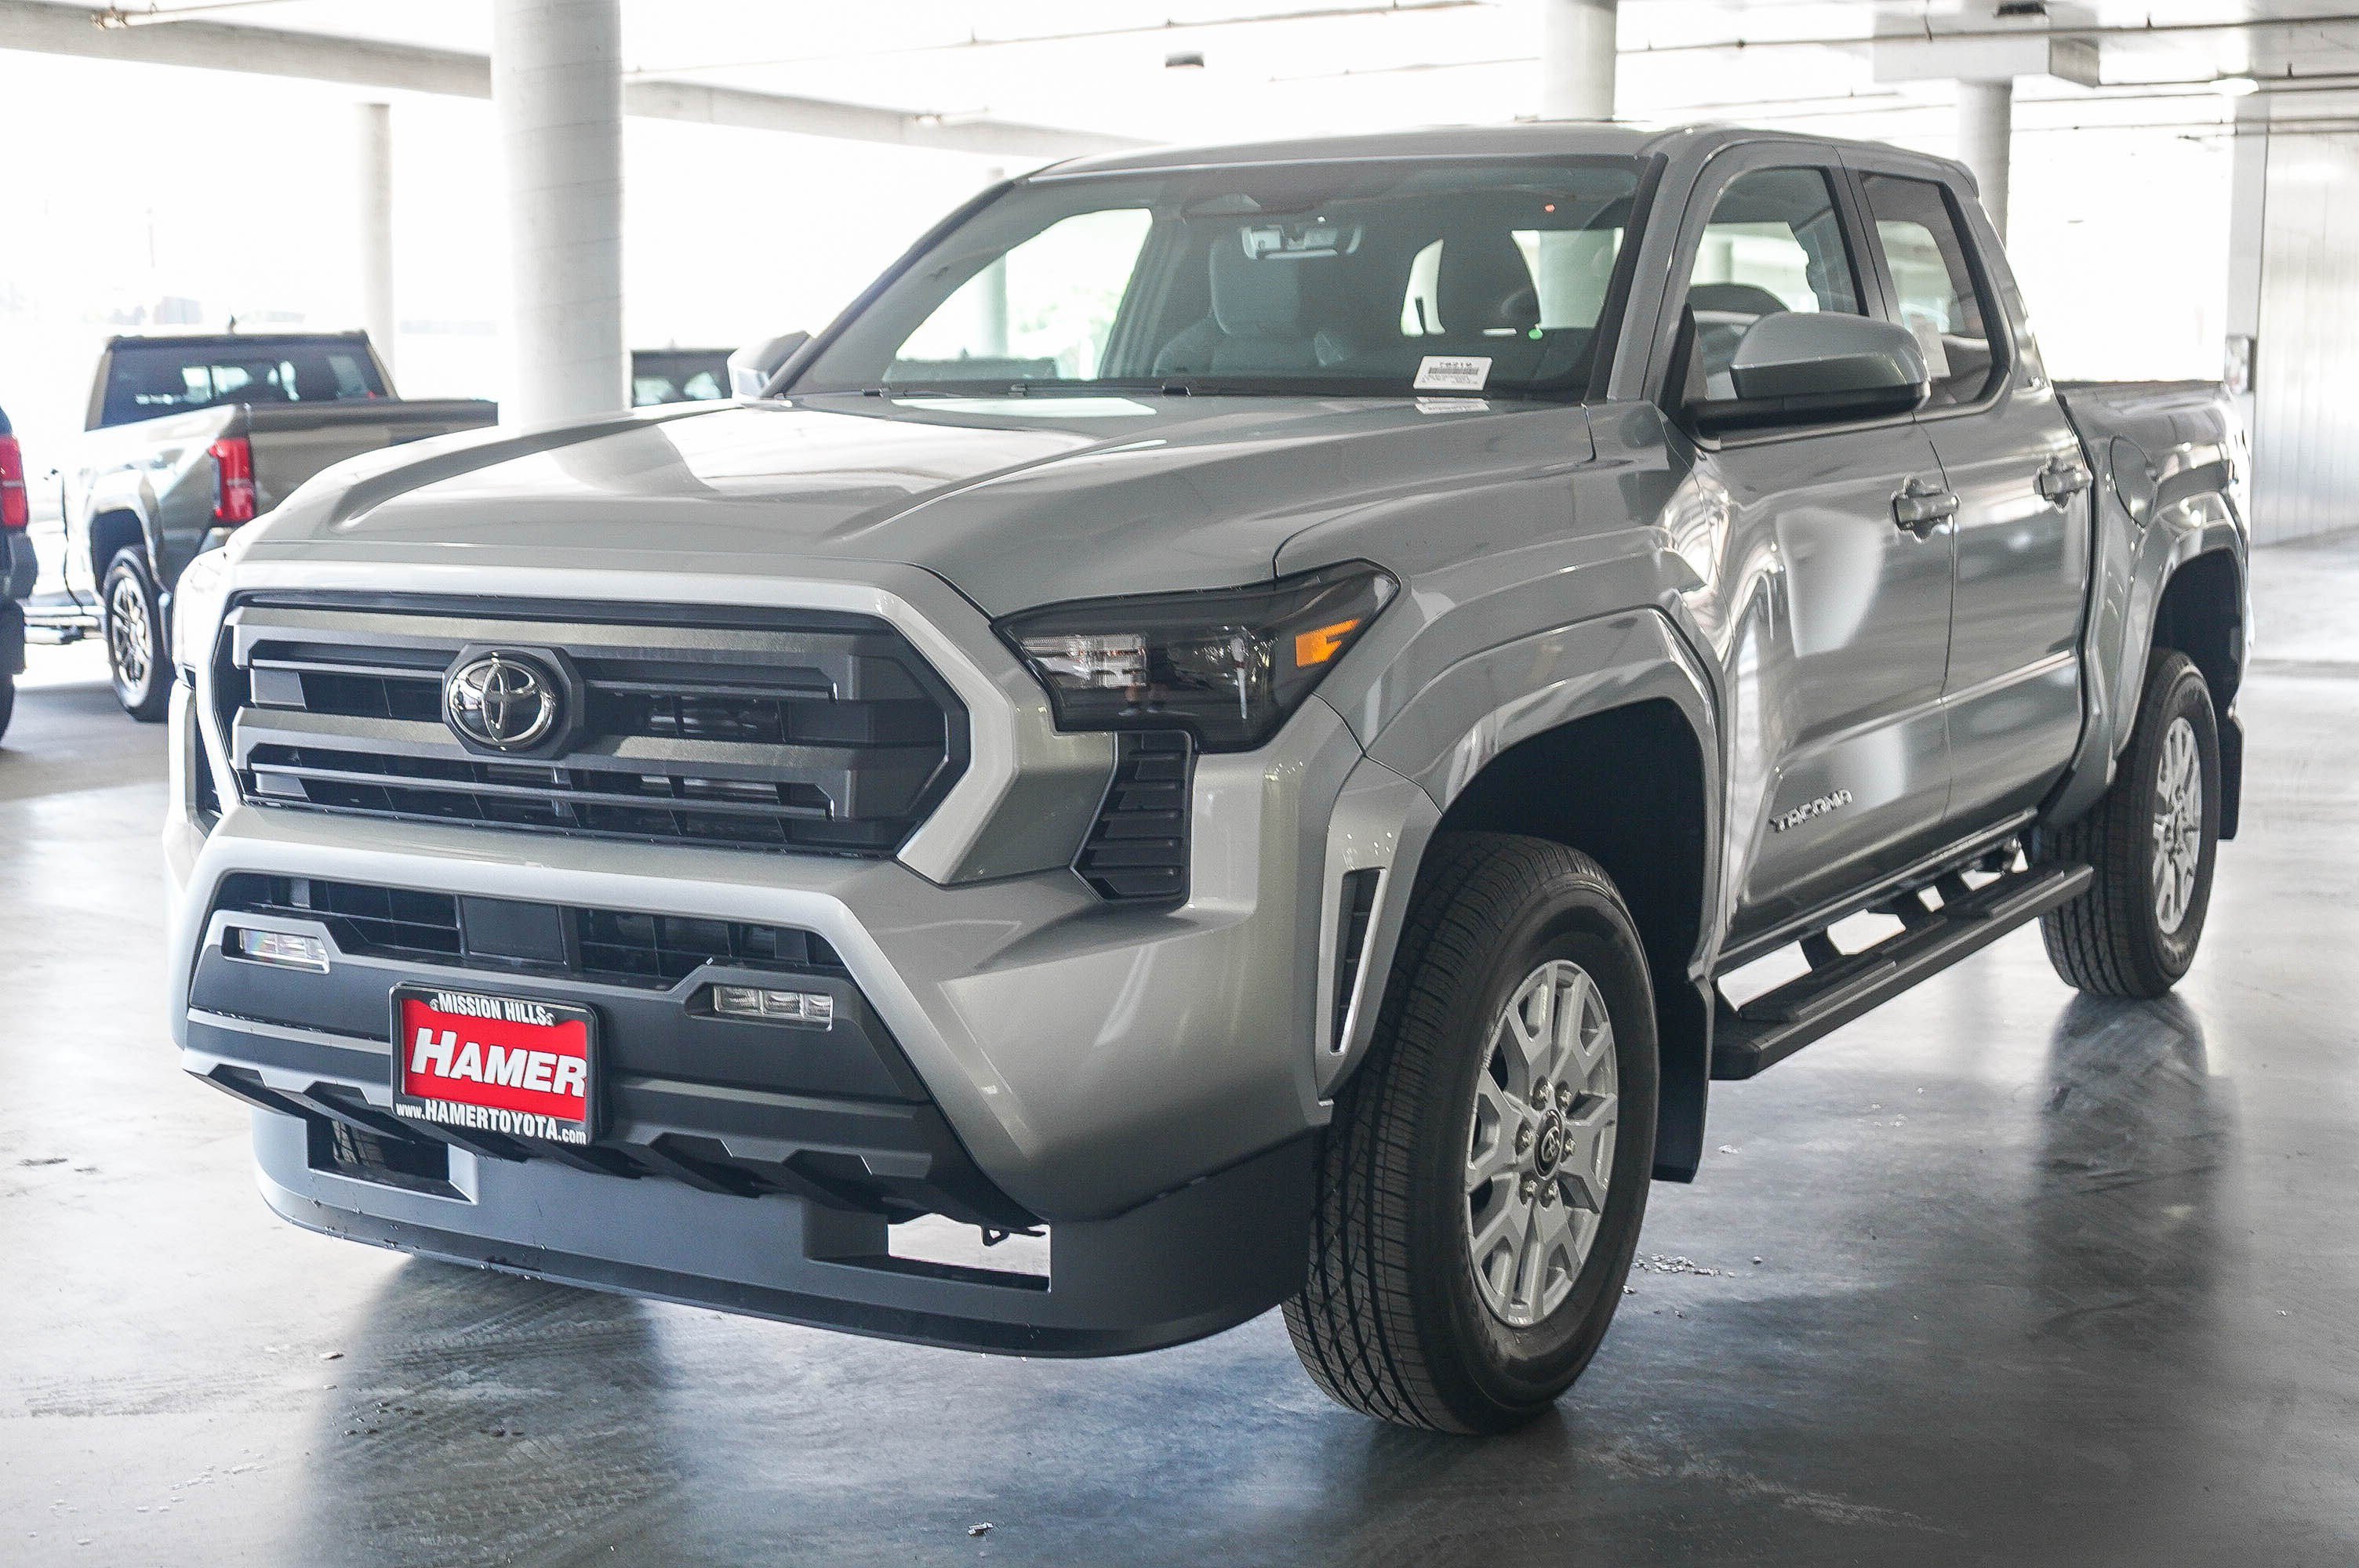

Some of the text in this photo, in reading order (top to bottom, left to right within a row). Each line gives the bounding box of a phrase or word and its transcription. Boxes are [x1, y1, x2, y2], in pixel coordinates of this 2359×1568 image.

[1769, 789, 1852, 833] TACOMA
[438, 992, 547, 1026] MISSION HILLS
[410, 1026, 587, 1098] HAMER
[395, 1098, 587, 1145] www.HAMERTOYOTA.com
